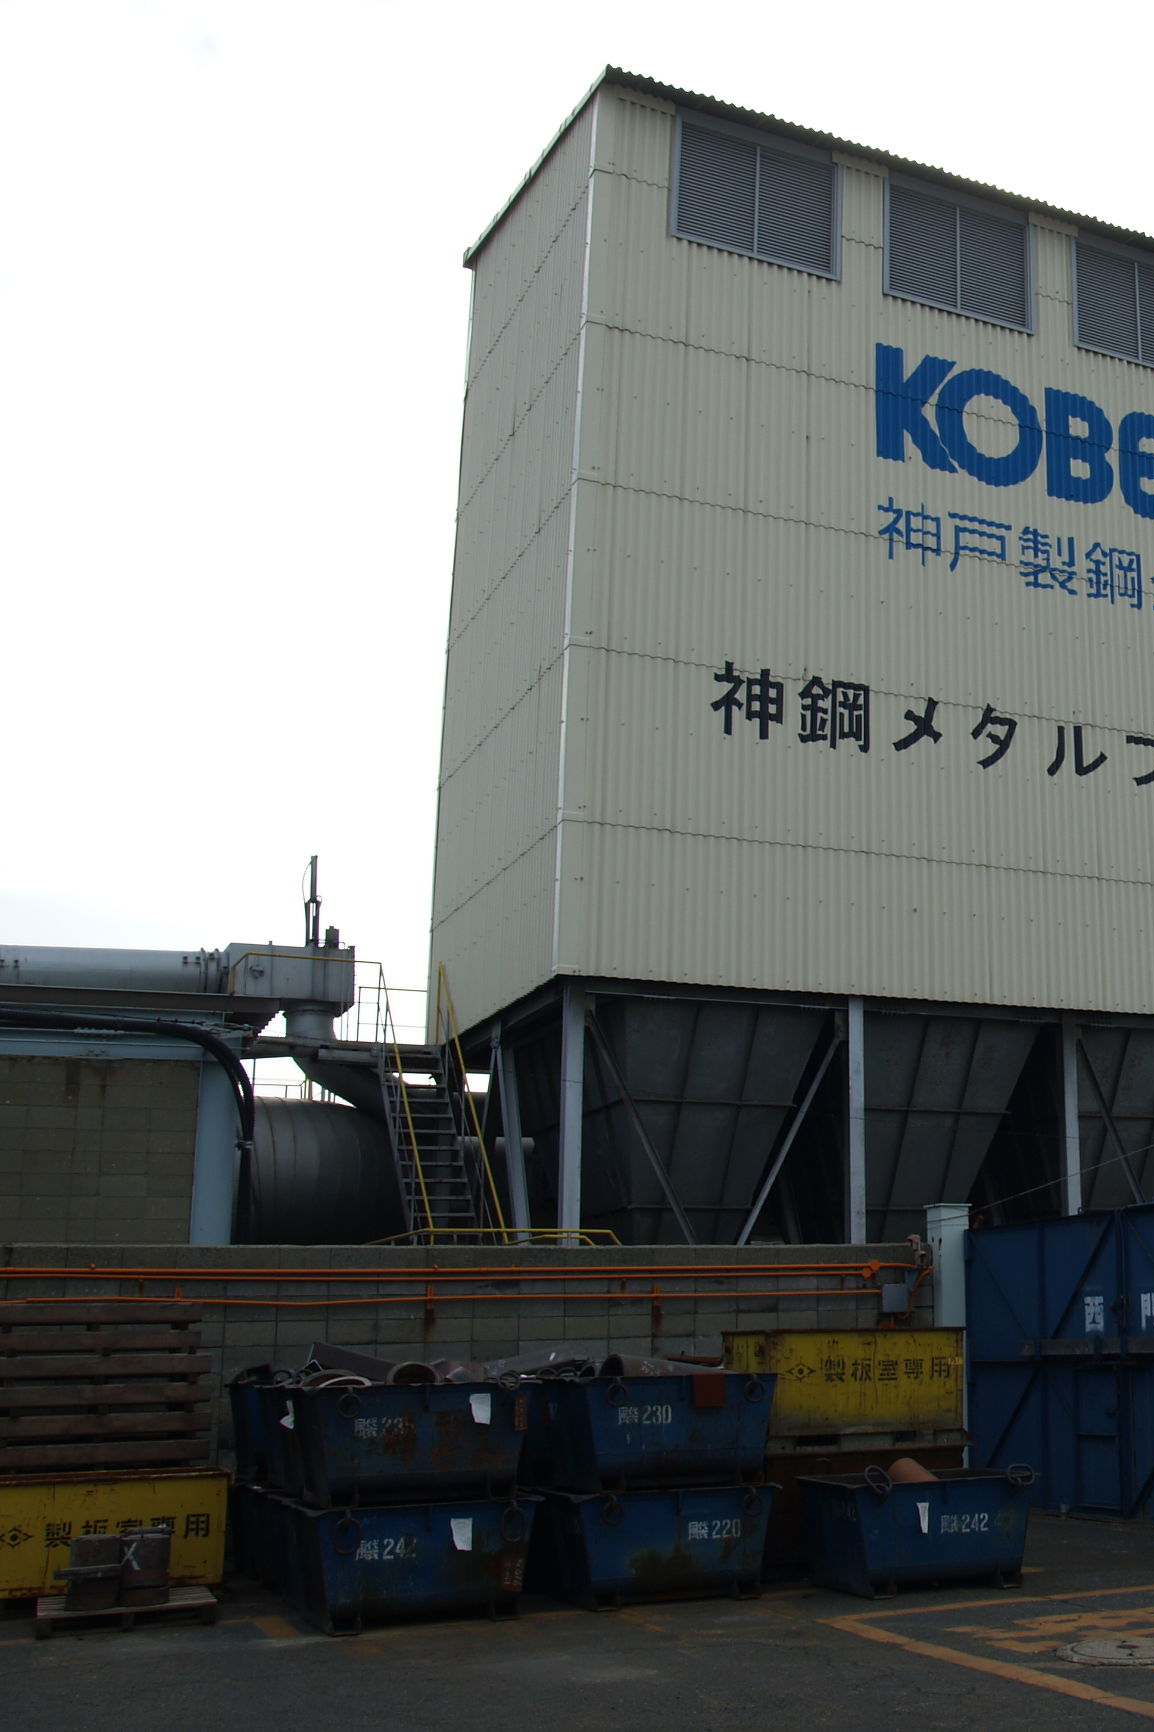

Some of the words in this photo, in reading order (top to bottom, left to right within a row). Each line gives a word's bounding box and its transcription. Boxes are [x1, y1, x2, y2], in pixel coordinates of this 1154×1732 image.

[642, 1404, 672, 1424] 230
[712, 1518, 741, 1538] 220
[962, 1513, 990, 1533] 242
